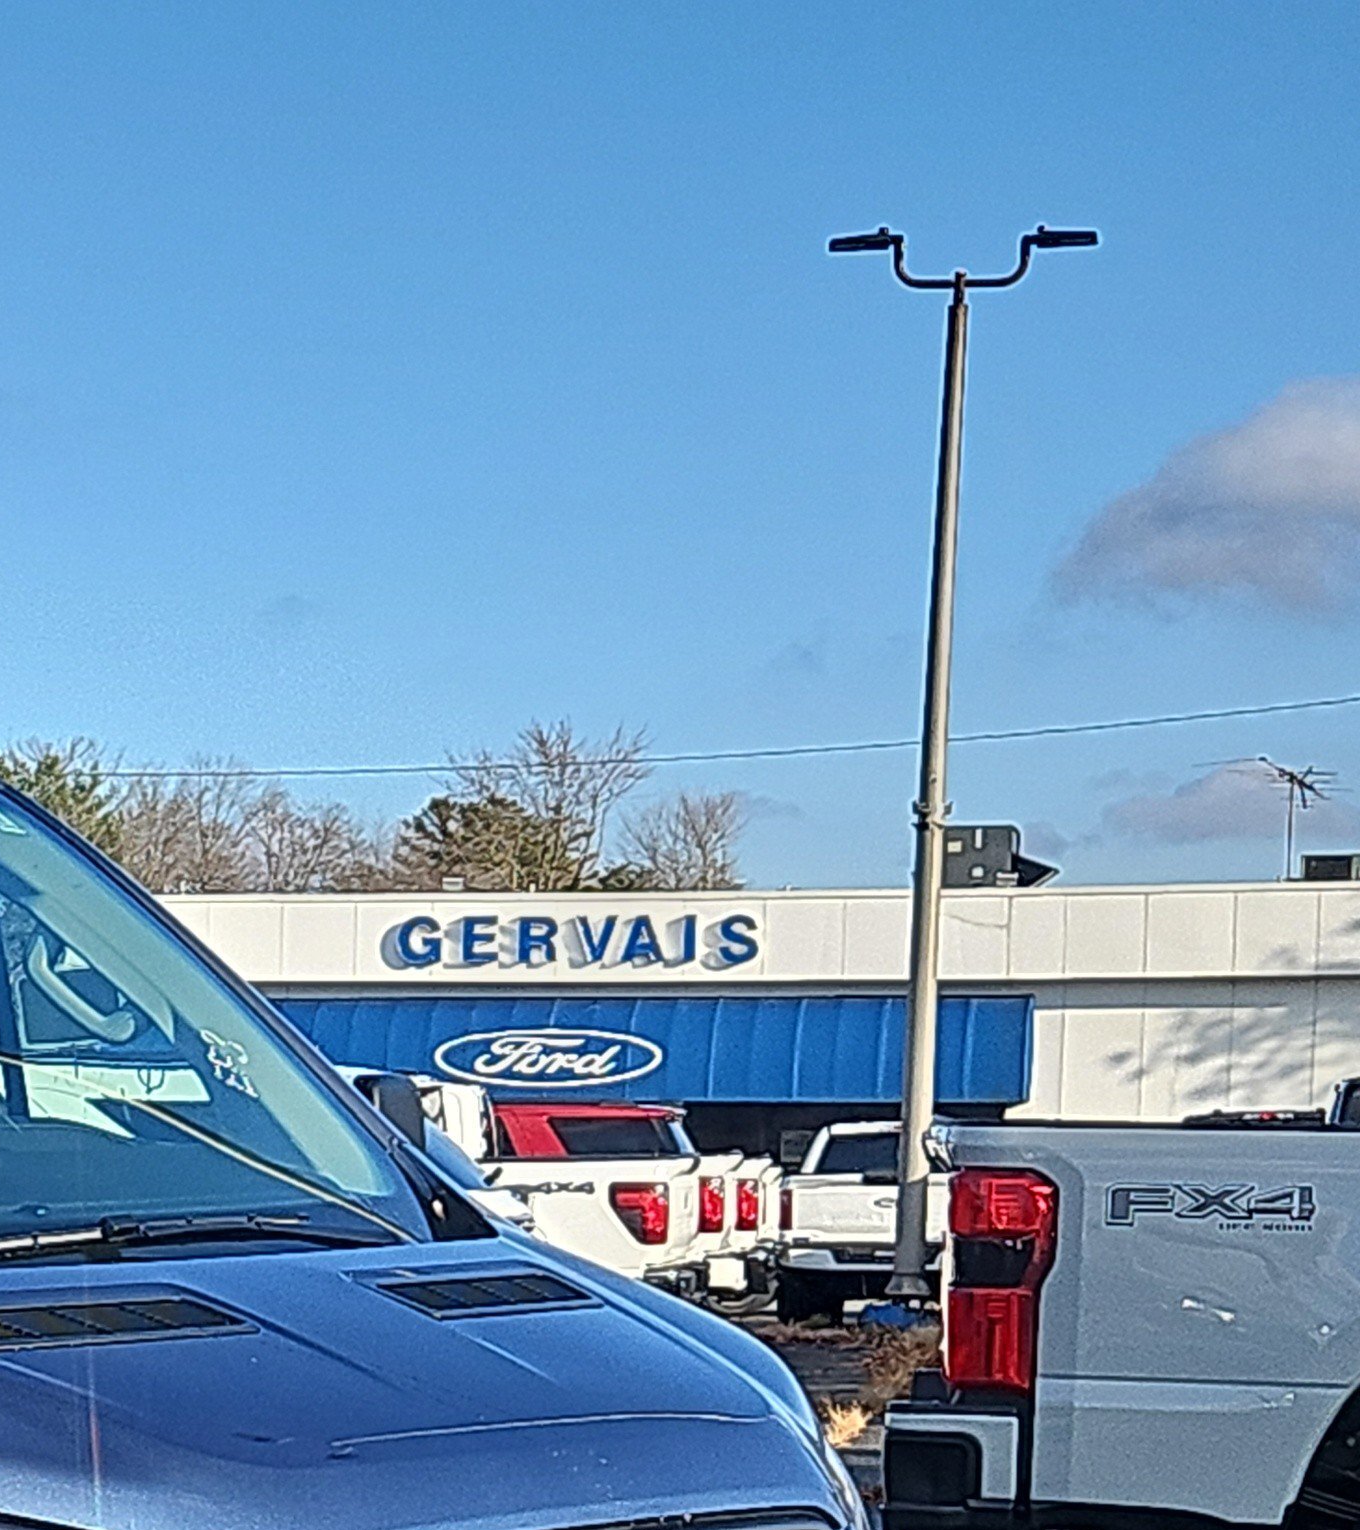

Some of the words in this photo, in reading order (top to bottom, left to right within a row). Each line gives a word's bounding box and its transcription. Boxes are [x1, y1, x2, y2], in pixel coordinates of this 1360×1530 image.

[380, 914, 760, 970] GERVAIS
[473, 1035, 616, 1077] Ford
[1104, 1182, 1317, 1227] FX4
